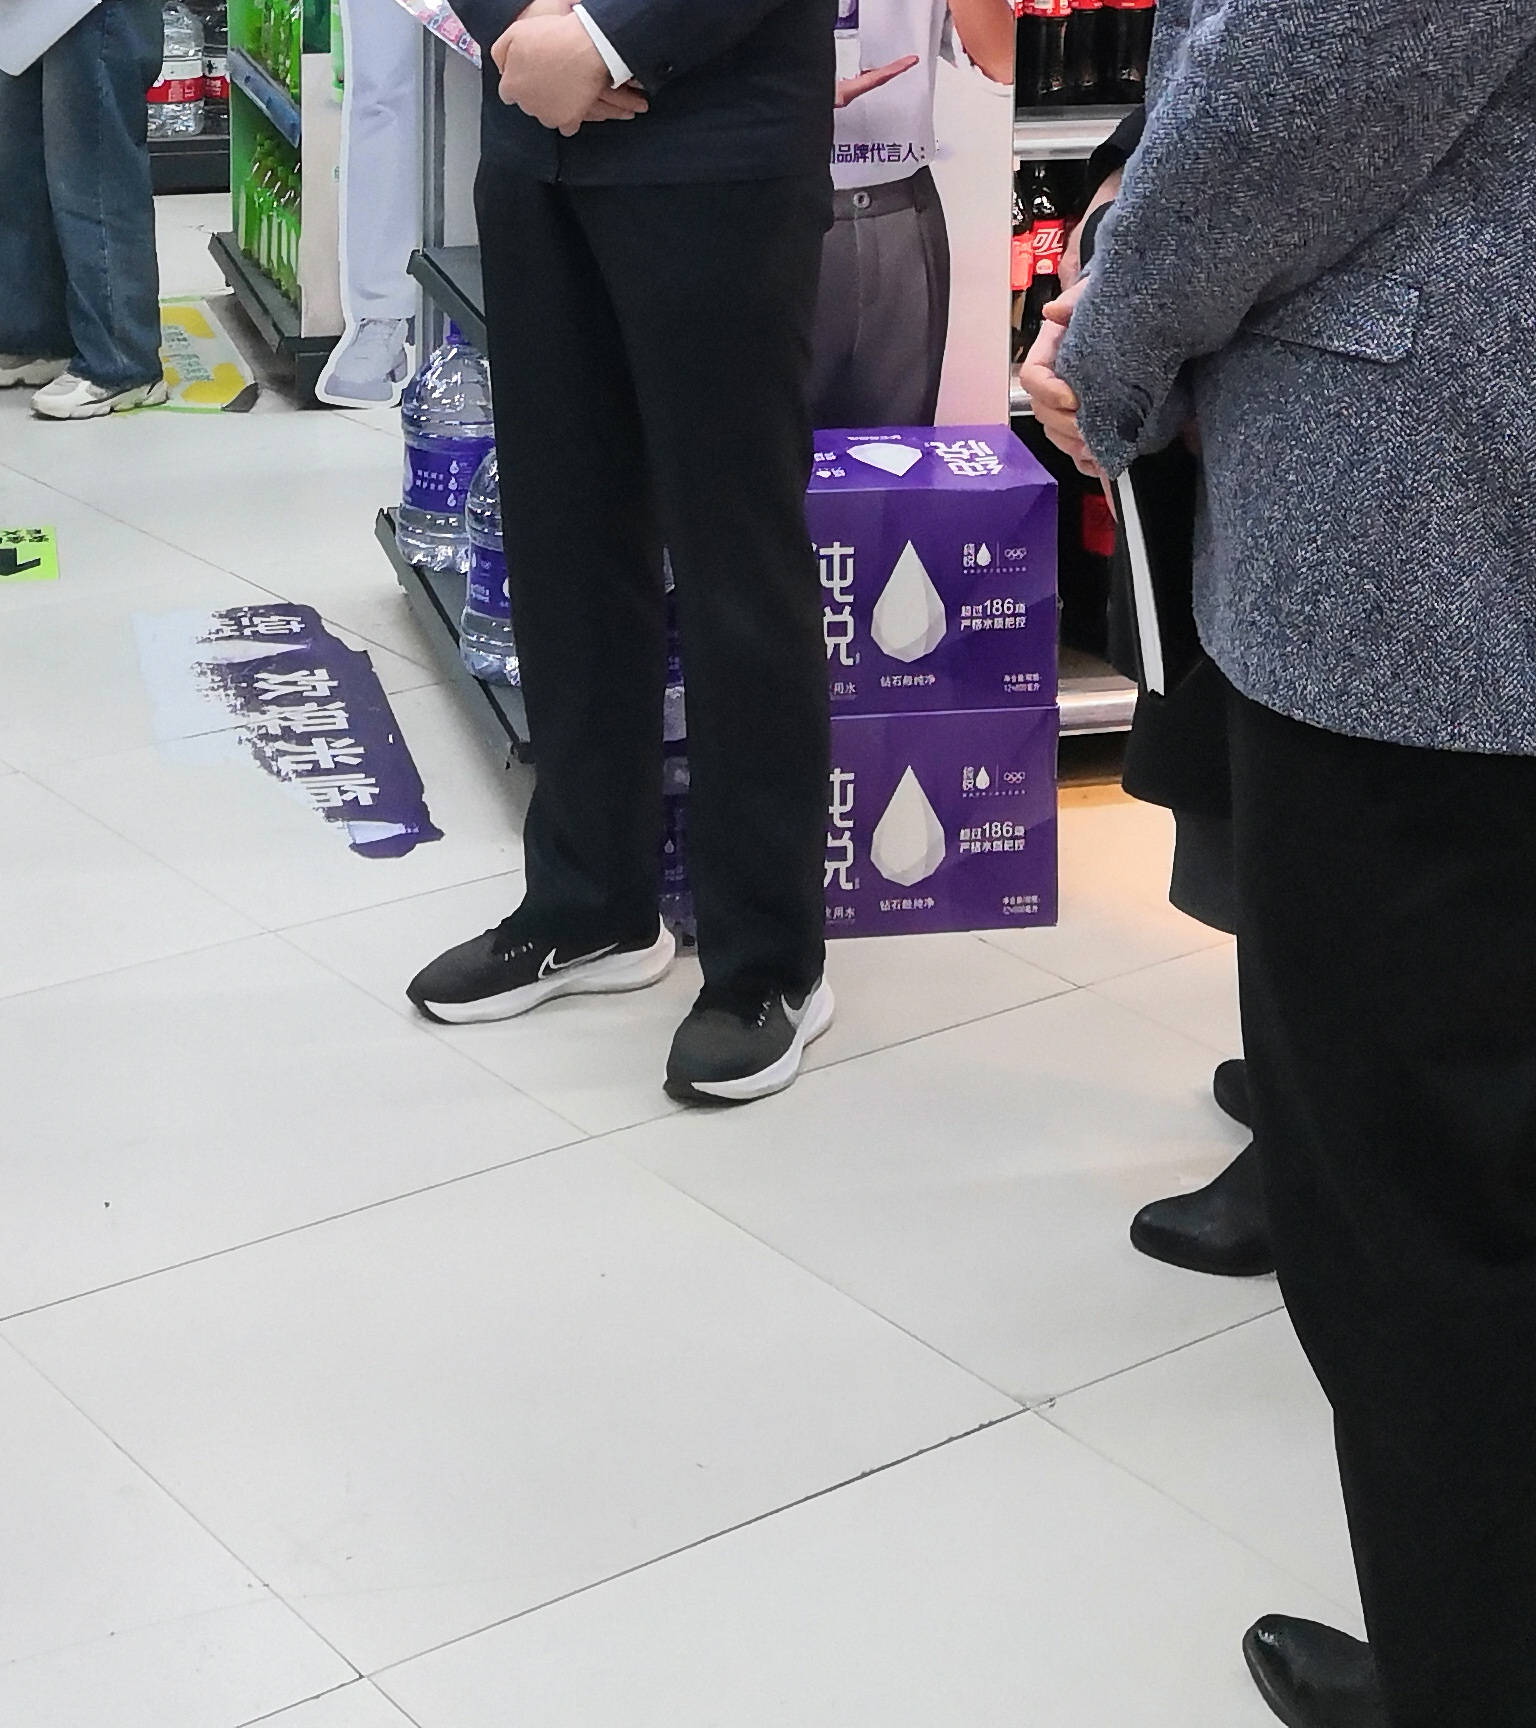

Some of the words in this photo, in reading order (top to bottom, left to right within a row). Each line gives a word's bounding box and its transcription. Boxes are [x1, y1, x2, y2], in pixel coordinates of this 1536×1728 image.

[831, 142, 924, 164] 品牌代言人:
[251, 668, 381, 808] 欢迎光临
